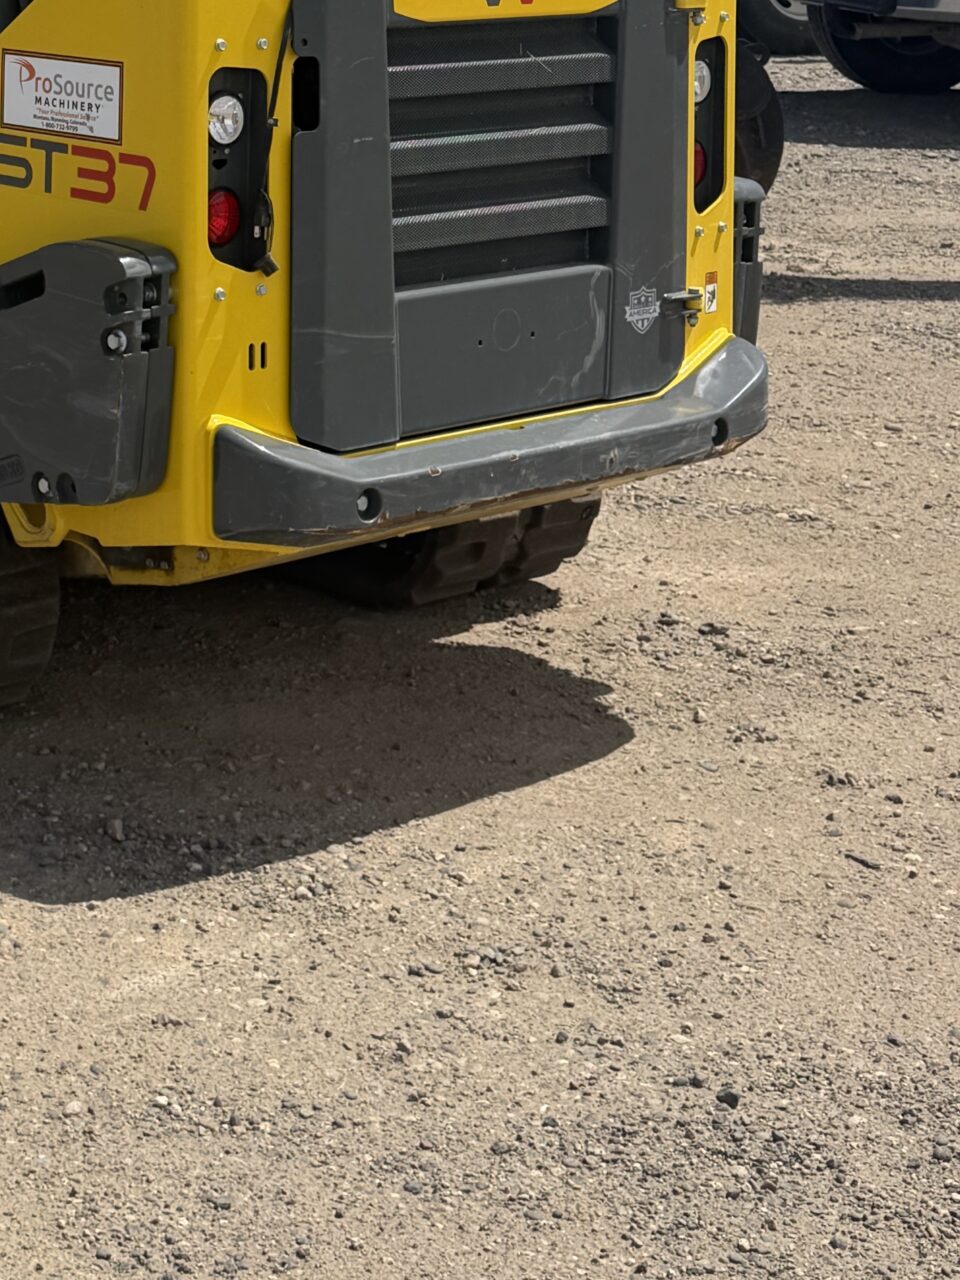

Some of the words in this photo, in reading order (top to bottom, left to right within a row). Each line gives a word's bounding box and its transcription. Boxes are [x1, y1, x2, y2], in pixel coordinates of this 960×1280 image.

[9, 57, 115, 102] ProSource
[34, 95, 101, 113] MACHINERY
[628, 306, 657, 319] AMERICA
